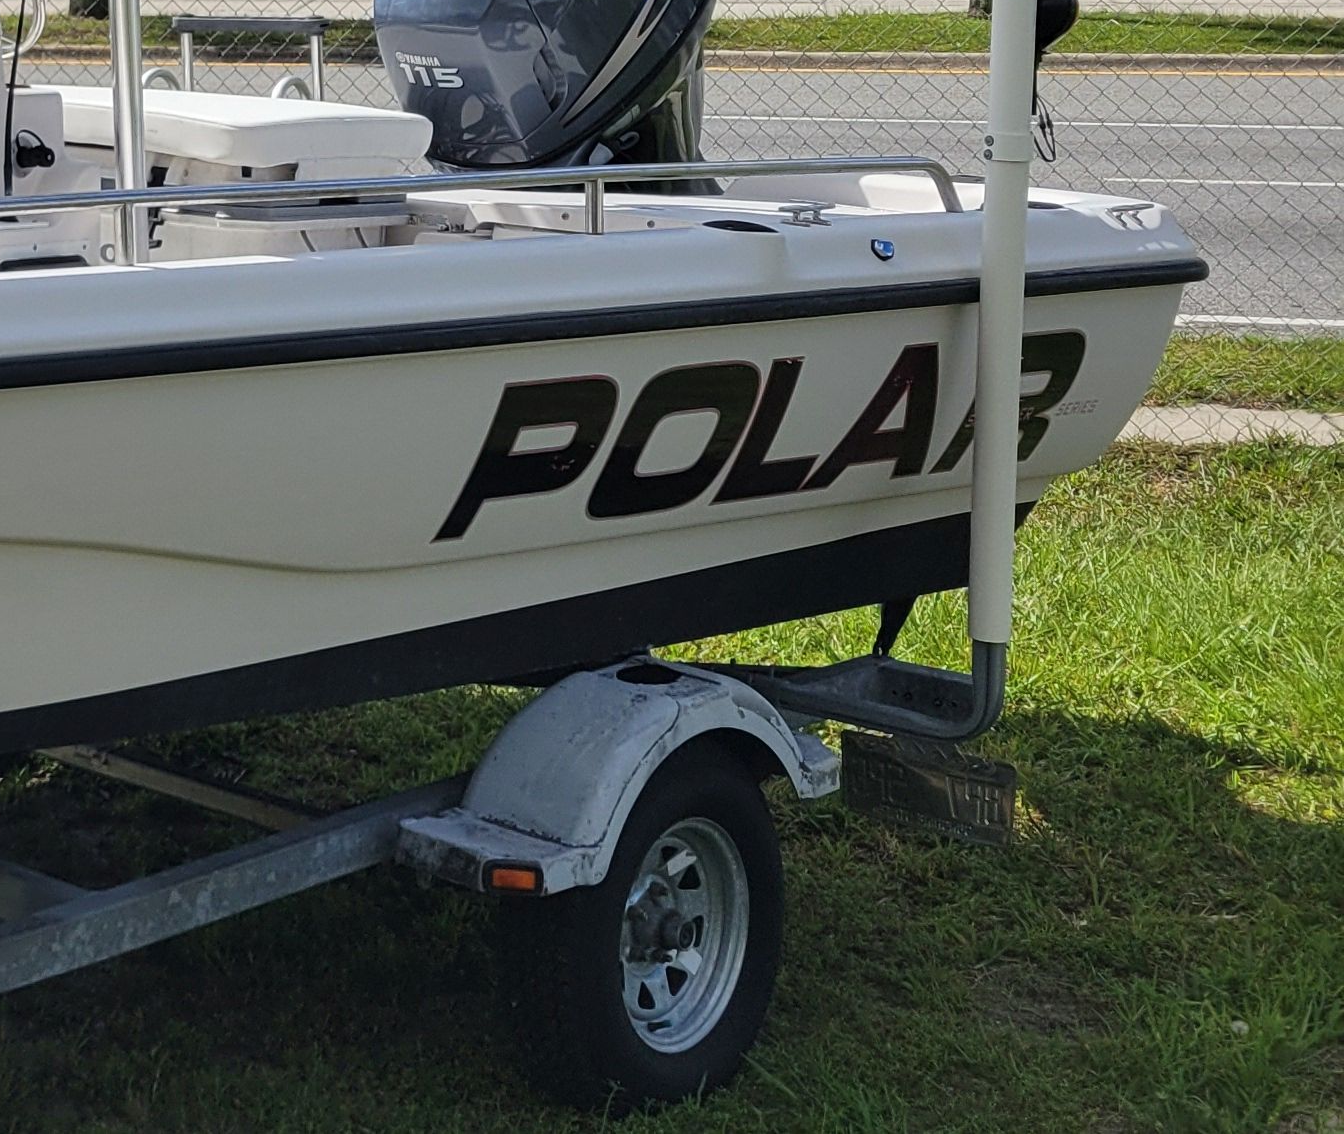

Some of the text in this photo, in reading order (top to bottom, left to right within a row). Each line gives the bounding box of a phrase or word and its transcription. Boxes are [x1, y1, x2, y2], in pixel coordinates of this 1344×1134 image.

[403, 53, 441, 67] YAMAHA
[399, 62, 464, 88] 115
[1056, 399, 1099, 417] SERIES
[430, 328, 1087, 544] POLAR
